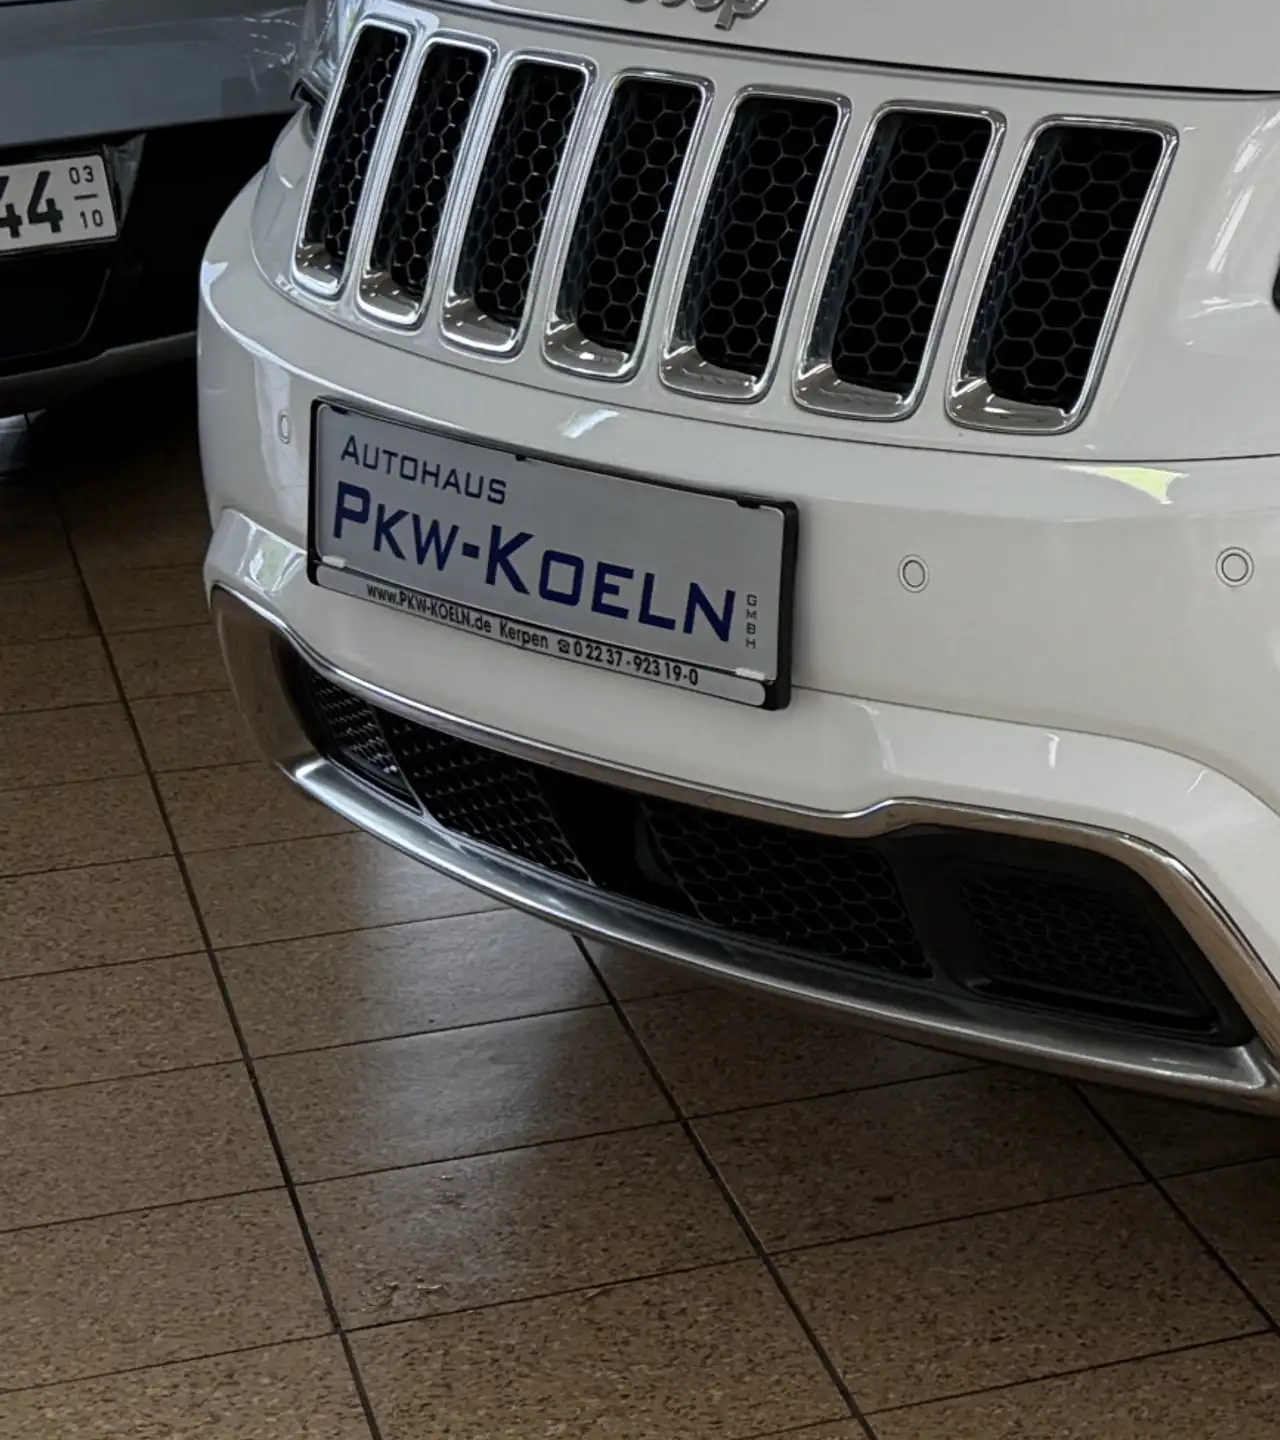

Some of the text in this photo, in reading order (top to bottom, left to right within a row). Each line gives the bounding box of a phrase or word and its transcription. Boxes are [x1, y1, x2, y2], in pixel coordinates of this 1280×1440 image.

[69, 165, 94, 184] 03
[80, 209, 104, 229] 10
[341, 434, 508, 505] AUTOHAUS
[333, 480, 737, 643] PKW-KOELN
[366, 583, 491, 633] www.PKW-KOELN.de
[499, 619, 549, 649] Kerpen
